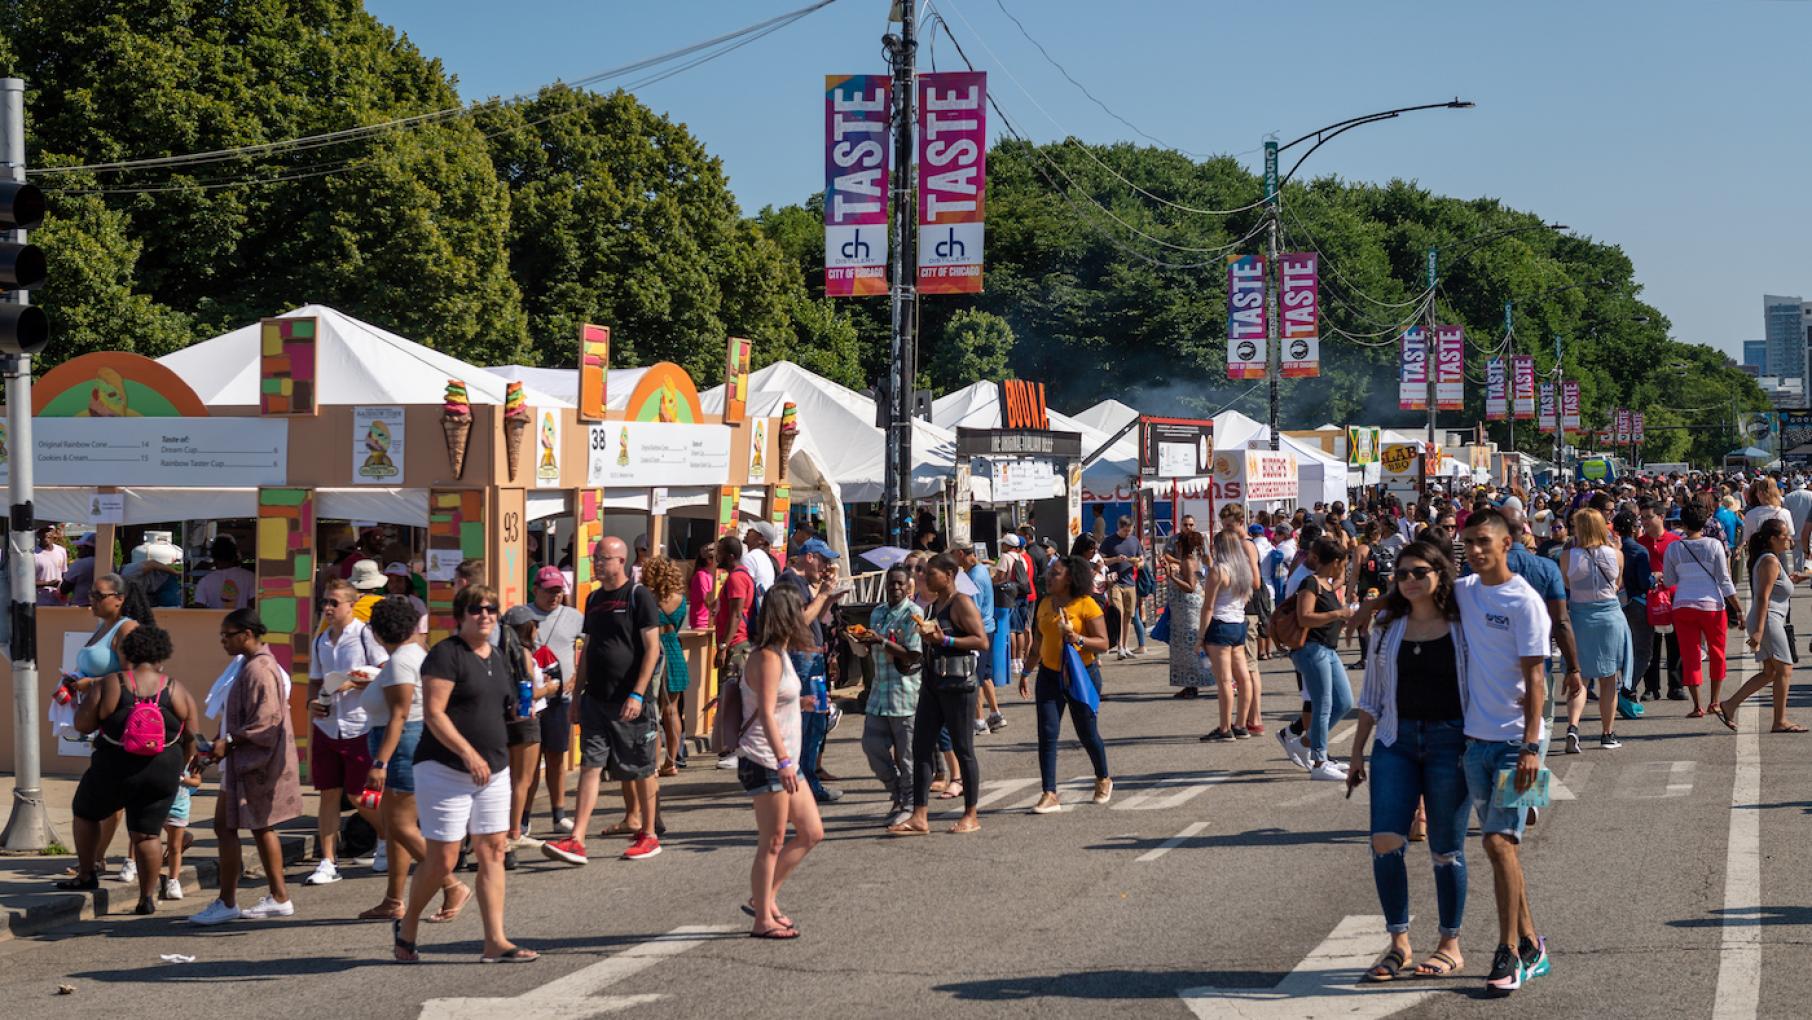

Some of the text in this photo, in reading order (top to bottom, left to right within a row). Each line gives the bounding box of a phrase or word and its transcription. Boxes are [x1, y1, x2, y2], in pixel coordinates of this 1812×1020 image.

[833, 88, 884, 222] TASTE
[926, 86, 978, 222] TASTE
[841, 228, 870, 259] ch
[935, 227, 964, 257] ch
[828, 267, 884, 280] CITY OF CHICAGO
[920, 266, 979, 278] CITY OF CHICAGO
[1233, 262, 1263, 338] TASTE
[1284, 260, 1314, 336] TASTE
[1403, 330, 1426, 382] TASTE
[1439, 330, 1461, 382] TASTE
[1488, 359, 1504, 399] TASTE
[1516, 359, 1532, 399] TASTE
[1540, 384, 1554, 416] TASTE
[1564, 384, 1578, 416] TASTE
[38, 440, 62, 450] Original
[64, 440, 90, 448] Rainbow
[92, 440, 108, 448] Cone
[184, 446, 198, 454] Cup
[592, 429, 606, 450] 38
[210, 460, 224, 468] Cup
[1388, 460, 1409, 472] BBQ
[504, 512, 519, 543] 93
